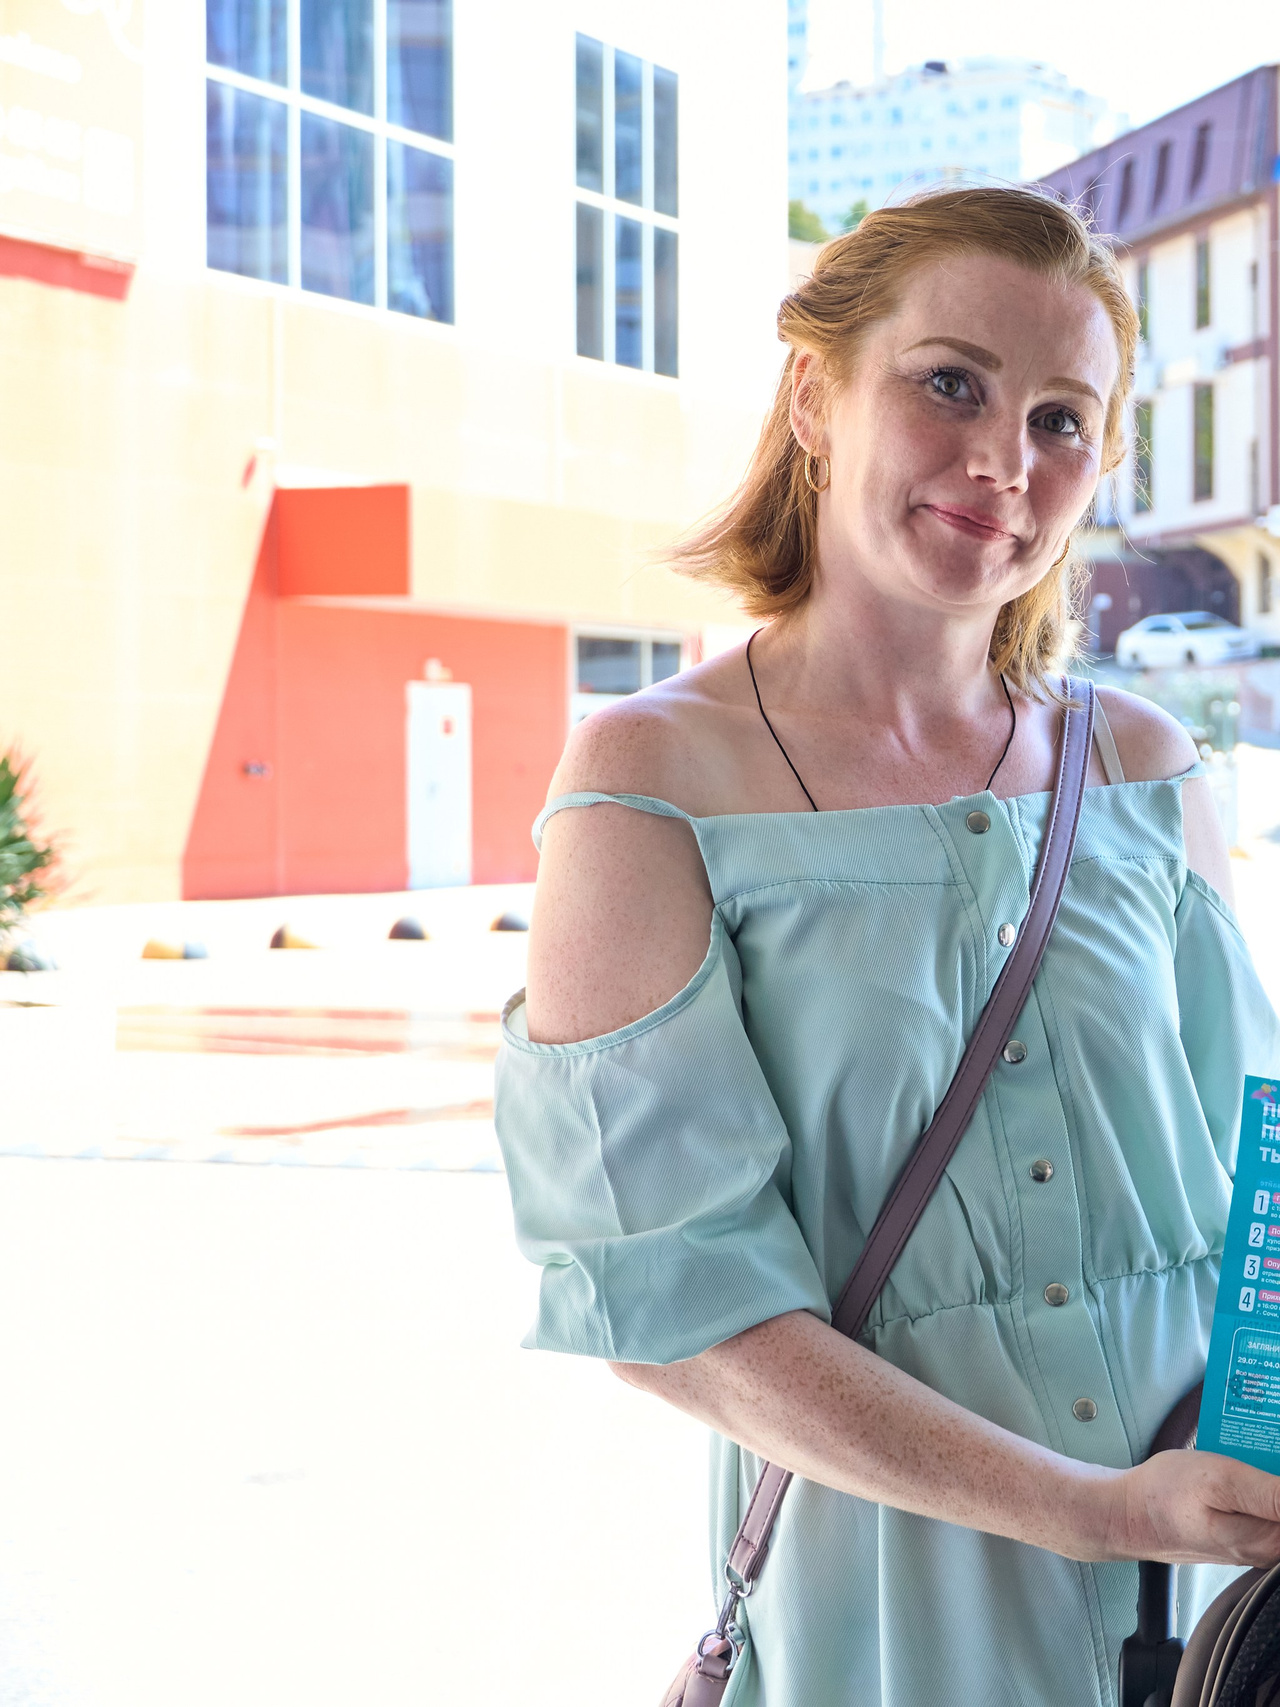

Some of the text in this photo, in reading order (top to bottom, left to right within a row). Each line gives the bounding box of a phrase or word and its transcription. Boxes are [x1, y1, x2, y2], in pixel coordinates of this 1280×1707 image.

[1258, 1194, 1265, 1211] 1
[1251, 1227, 1262, 1244] 2
[1247, 1258, 1257, 1276] 3
[1241, 1291, 1251, 1309] 4
[1237, 1356, 1258, 1366] 29.07
